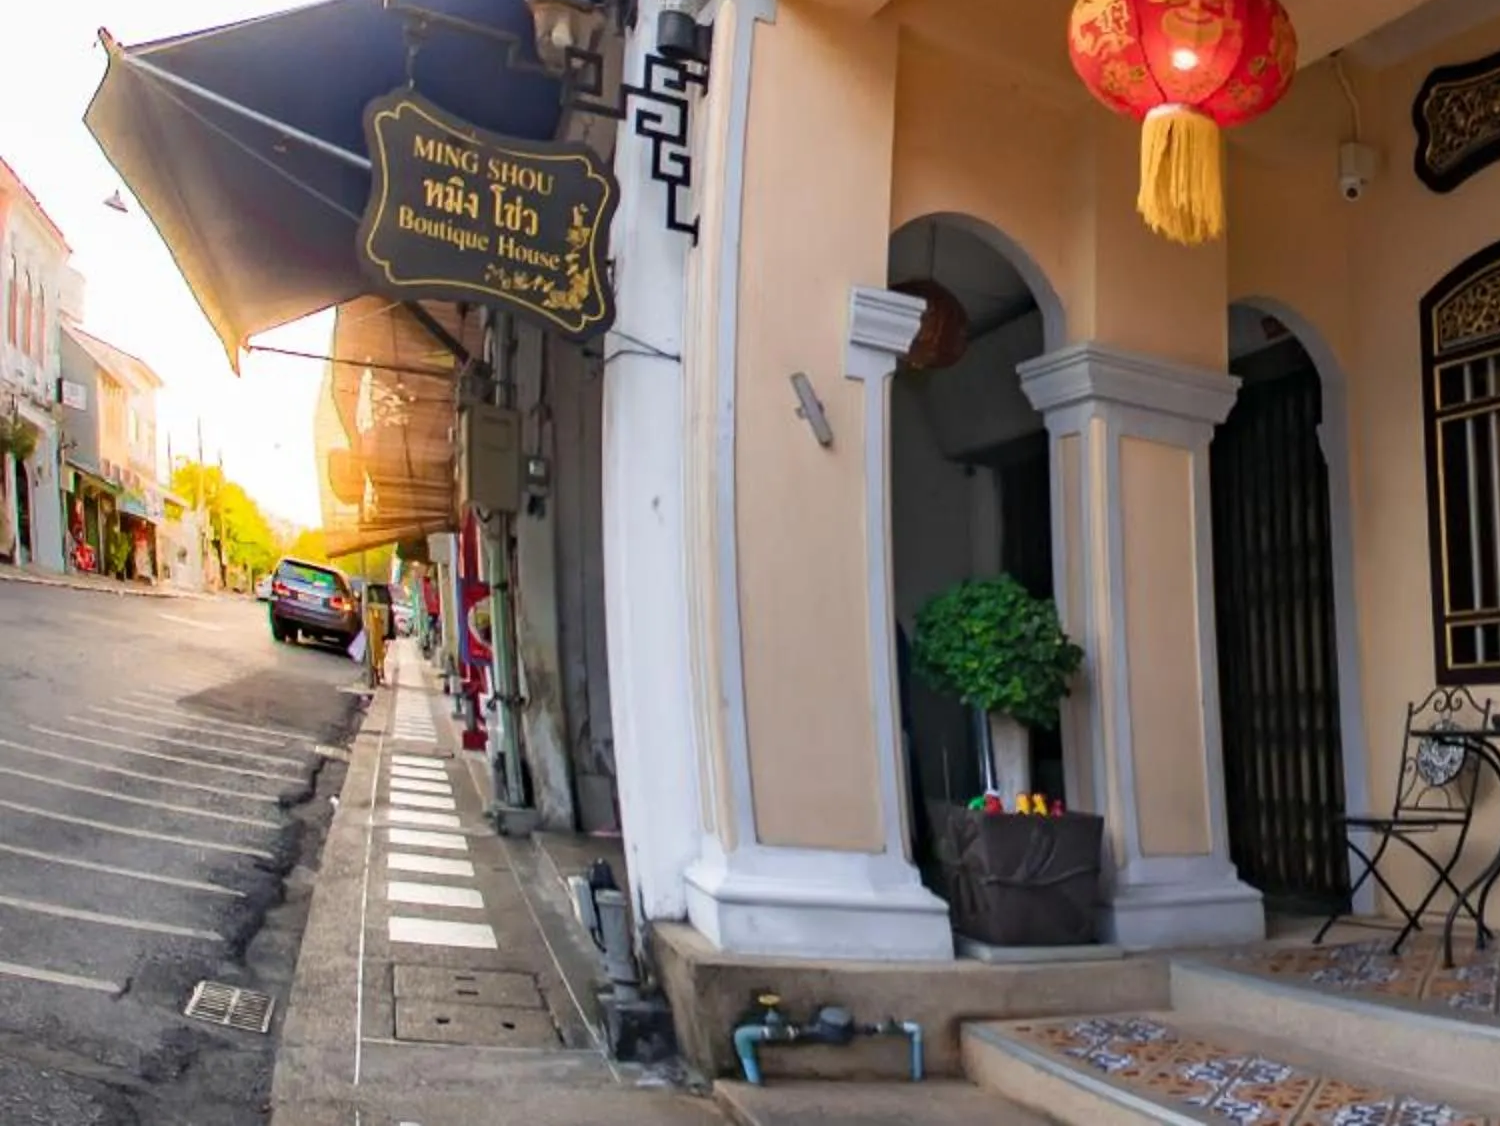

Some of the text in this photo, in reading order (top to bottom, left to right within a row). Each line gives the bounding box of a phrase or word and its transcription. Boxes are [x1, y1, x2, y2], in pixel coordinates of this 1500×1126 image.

[413, 134, 555, 196] MING SHOU
[399, 204, 561, 271] Boutique House
